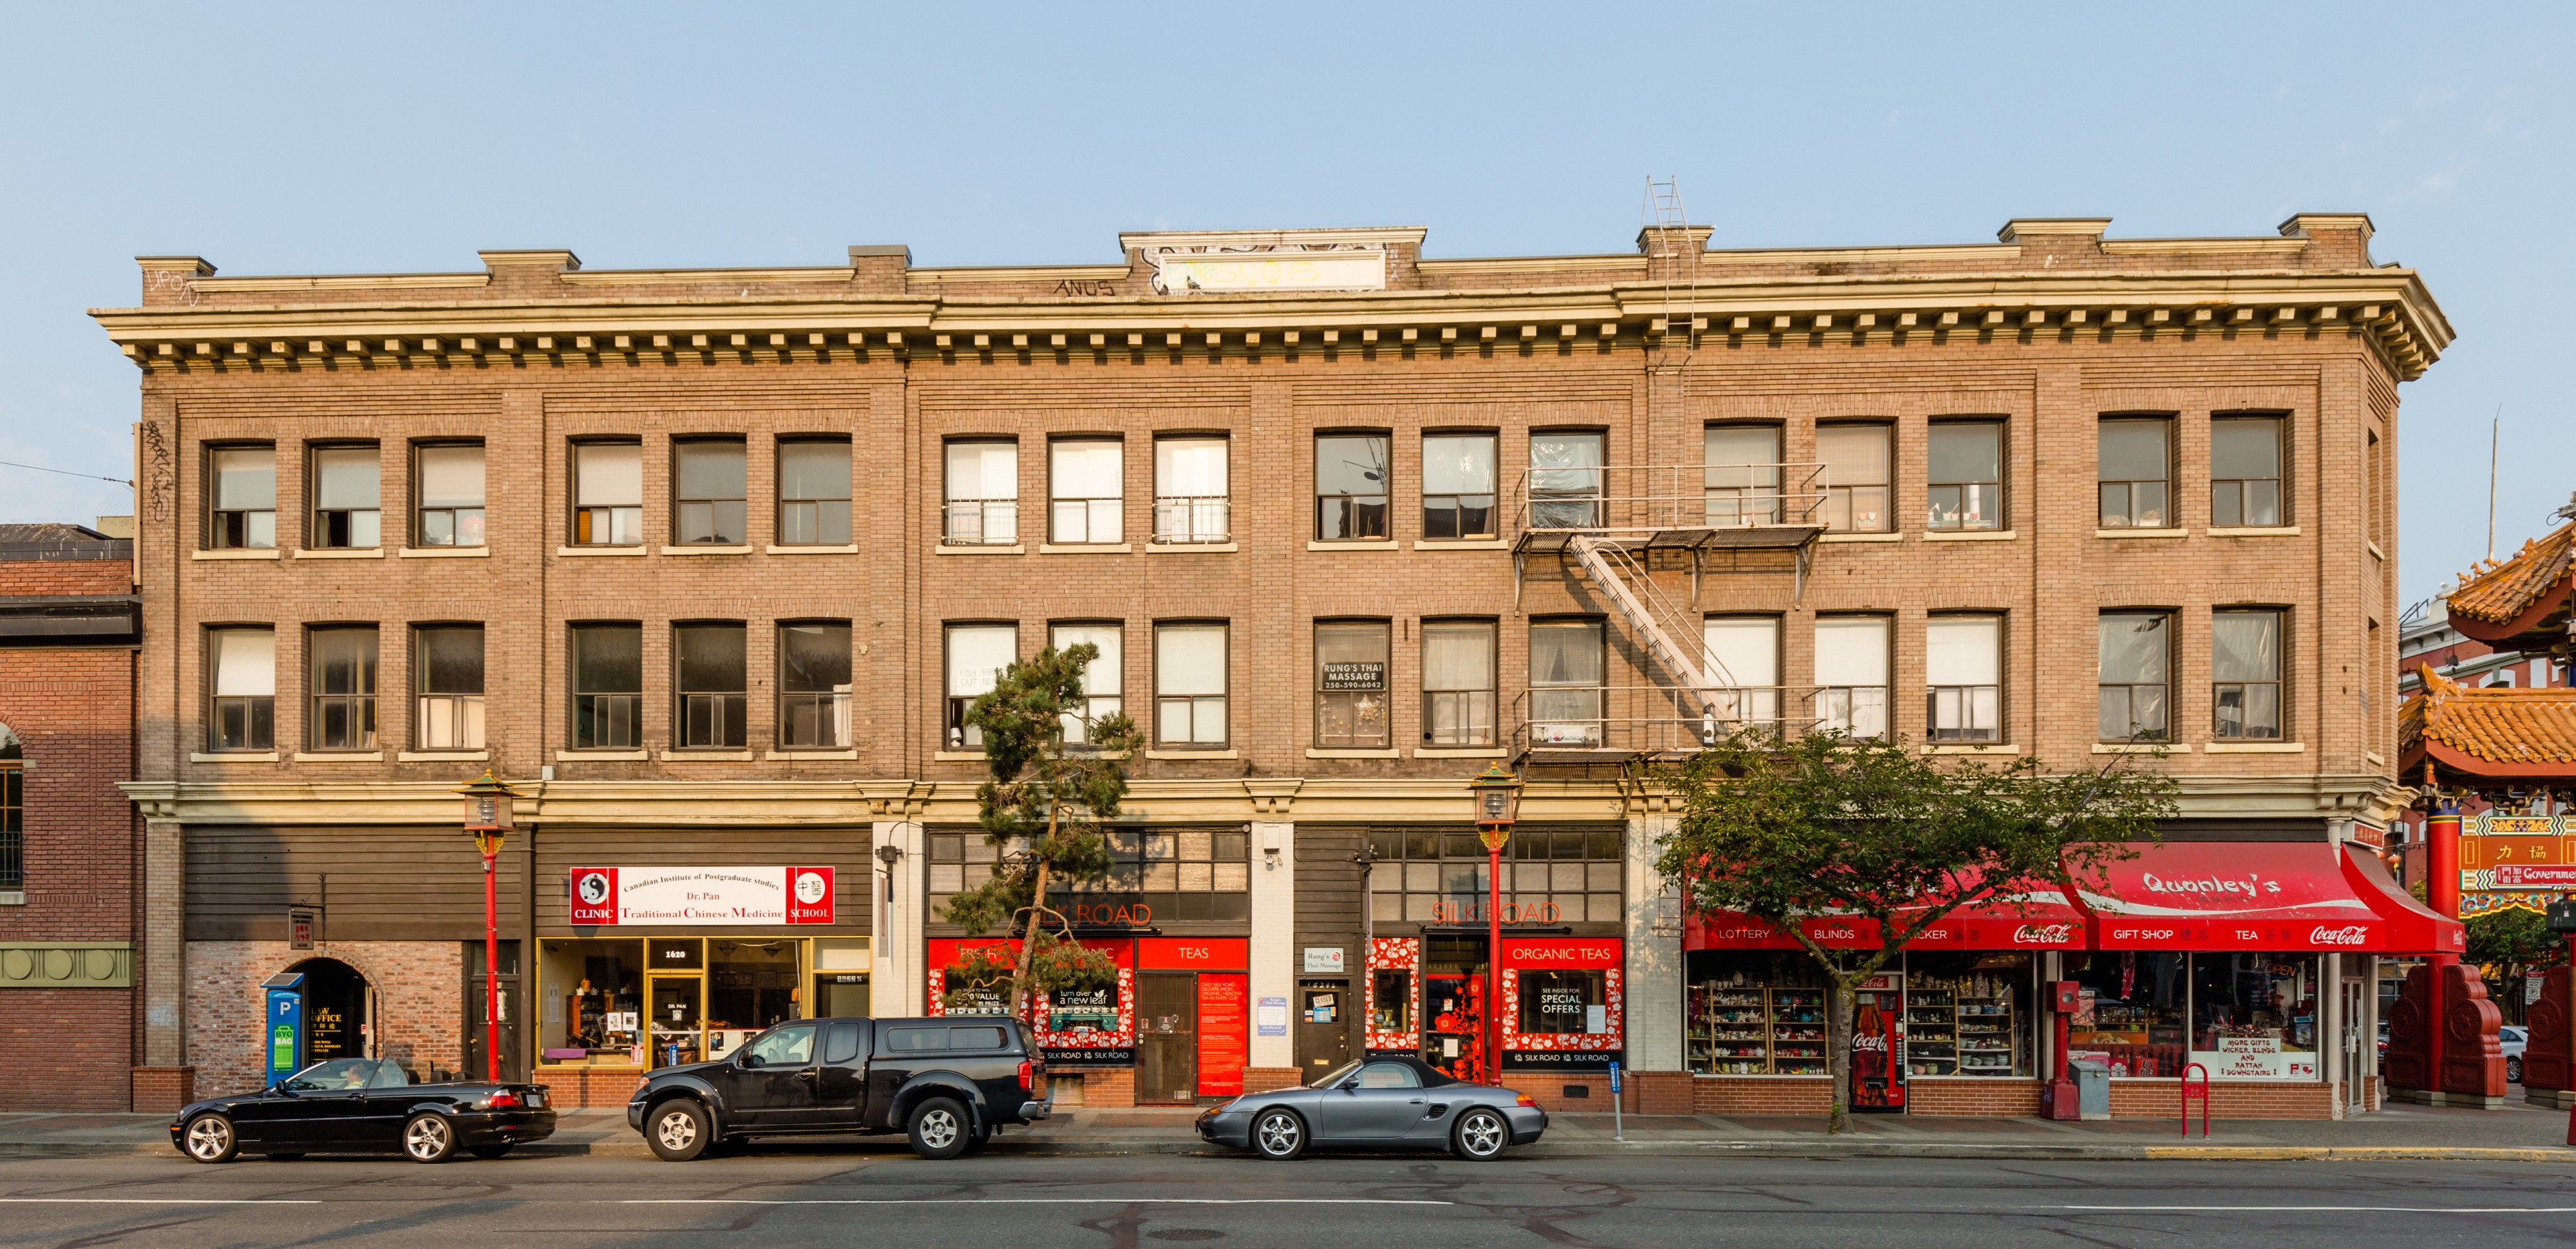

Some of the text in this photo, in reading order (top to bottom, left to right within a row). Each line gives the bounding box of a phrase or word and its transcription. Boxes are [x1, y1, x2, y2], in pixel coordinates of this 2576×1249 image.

[1053, 278, 1115, 297] ANUS
[1324, 664, 1358, 672] RUNG'S
[1329, 672, 1376, 681] MASSAGE
[960, 678, 977, 687] OUT
[624, 878, 658, 893] Canadian
[660, 875, 692, 883] Institute
[705, 873, 752, 883] Postgraduate
[754, 879, 779, 891] studies
[574, 909, 613, 919] CLINIC
[620, 907, 783, 918] Traditional Chinese Medicine
[790, 908, 829, 917] SCHOOL
[1077, 904, 1151, 925] ROAD
[1432, 902, 1479, 923] SILK
[1719, 930, 1770, 939] LOTTERY
[1814, 930, 1854, 939] BLINDS
[2114, 930, 2174, 940] GIFT SHOP
[2235, 930, 2259, 940] TEA
[2309, 925, 2369, 945] Coca-Cola
[1179, 948, 1209, 958] TEAS
[1513, 948, 1610, 960] ORGANIC TEAS
[2265, 963, 2297, 977] OPEN
[1090, 995, 1108, 1004] leaf
[1315, 995, 1332, 1004] CLOSED
[280, 1002, 291, 1015] P
[1542, 1005, 1580, 1013] OFFERS
